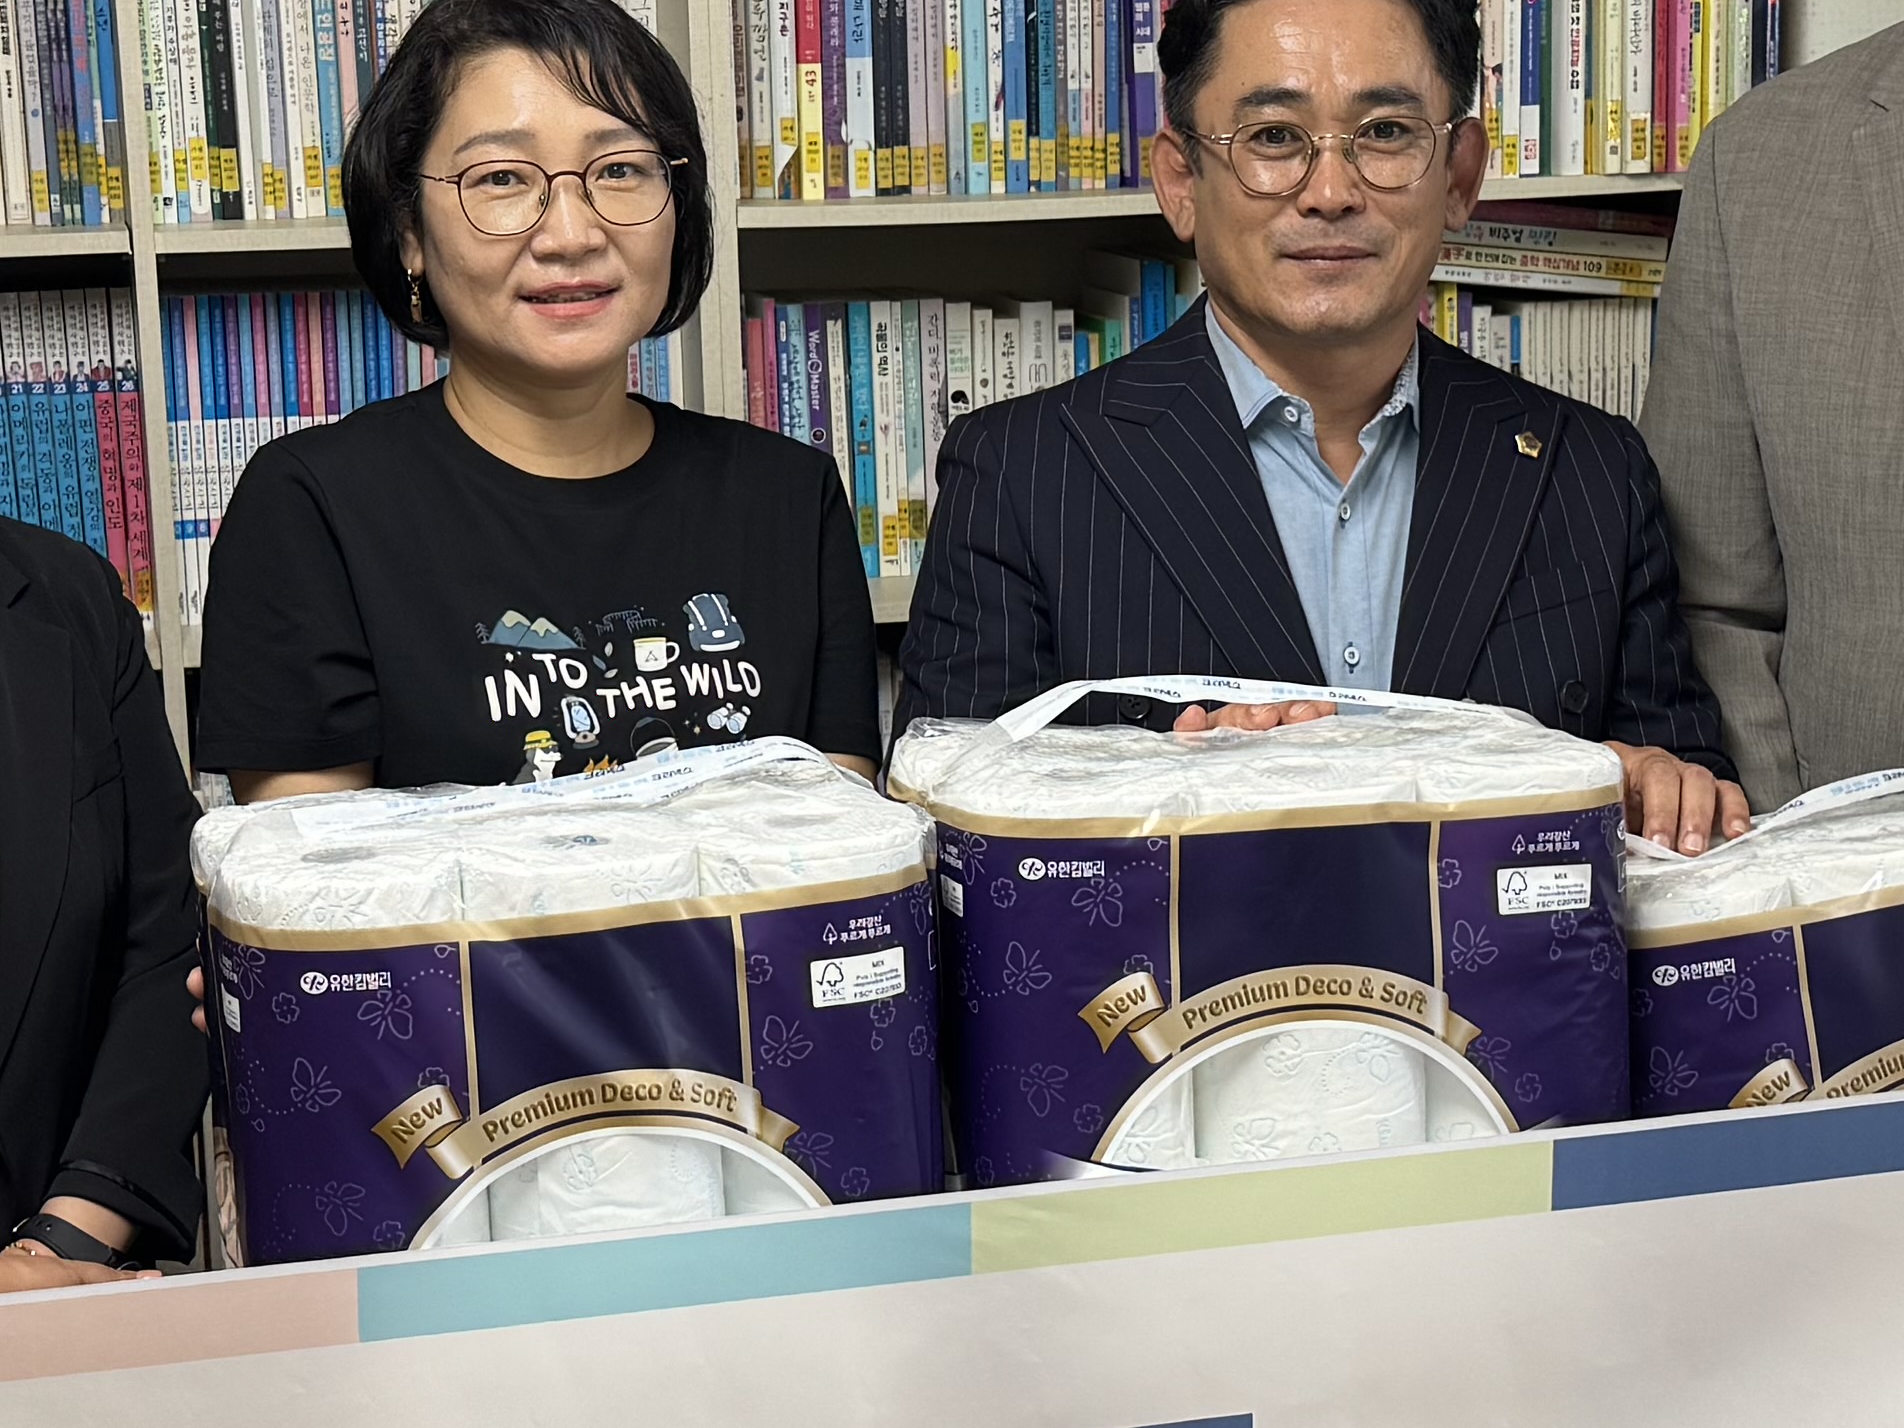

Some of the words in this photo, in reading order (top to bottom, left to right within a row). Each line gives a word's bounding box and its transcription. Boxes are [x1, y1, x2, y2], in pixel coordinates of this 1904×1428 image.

[318, 13, 332, 28] 인
[852, 15, 863, 44] 나라
[1630, 10, 1644, 56] 바다인가
[319, 31, 335, 61] 공장
[808, 329, 821, 360] Word
[11, 383, 24, 394] 21
[31, 383, 45, 394] 22
[53, 383, 67, 394] 23
[75, 382, 88, 393] 24
[97, 380, 110, 392] 25
[121, 380, 135, 392] 26
[810, 375, 822, 411] Master
[106, 497, 123, 530] 인도
[131, 529, 148, 561] 세계
[595, 676, 677, 720] THE
[680, 658, 763, 699] WILD
[1047, 858, 1107, 879] 유한킴벌리
[1506, 895, 1529, 906] FSC
[329, 970, 392, 993] 유한킴벌리
[1680, 958, 1737, 982] 유한킴벌리
[821, 986, 845, 999] FSC
[1182, 977, 1289, 1031] Premium
[1294, 974, 1354, 1000] Deco
[1359, 975, 1375, 998] &
[1379, 977, 1430, 1013] Soft
[1096, 985, 1150, 1030] New
[1747, 1070, 1792, 1107] New
[390, 1096, 444, 1147] New
[482, 1082, 596, 1143] Premium
[600, 1079, 663, 1106] Deco
[668, 1079, 686, 1104] &
[690, 1080, 738, 1113] Soft
